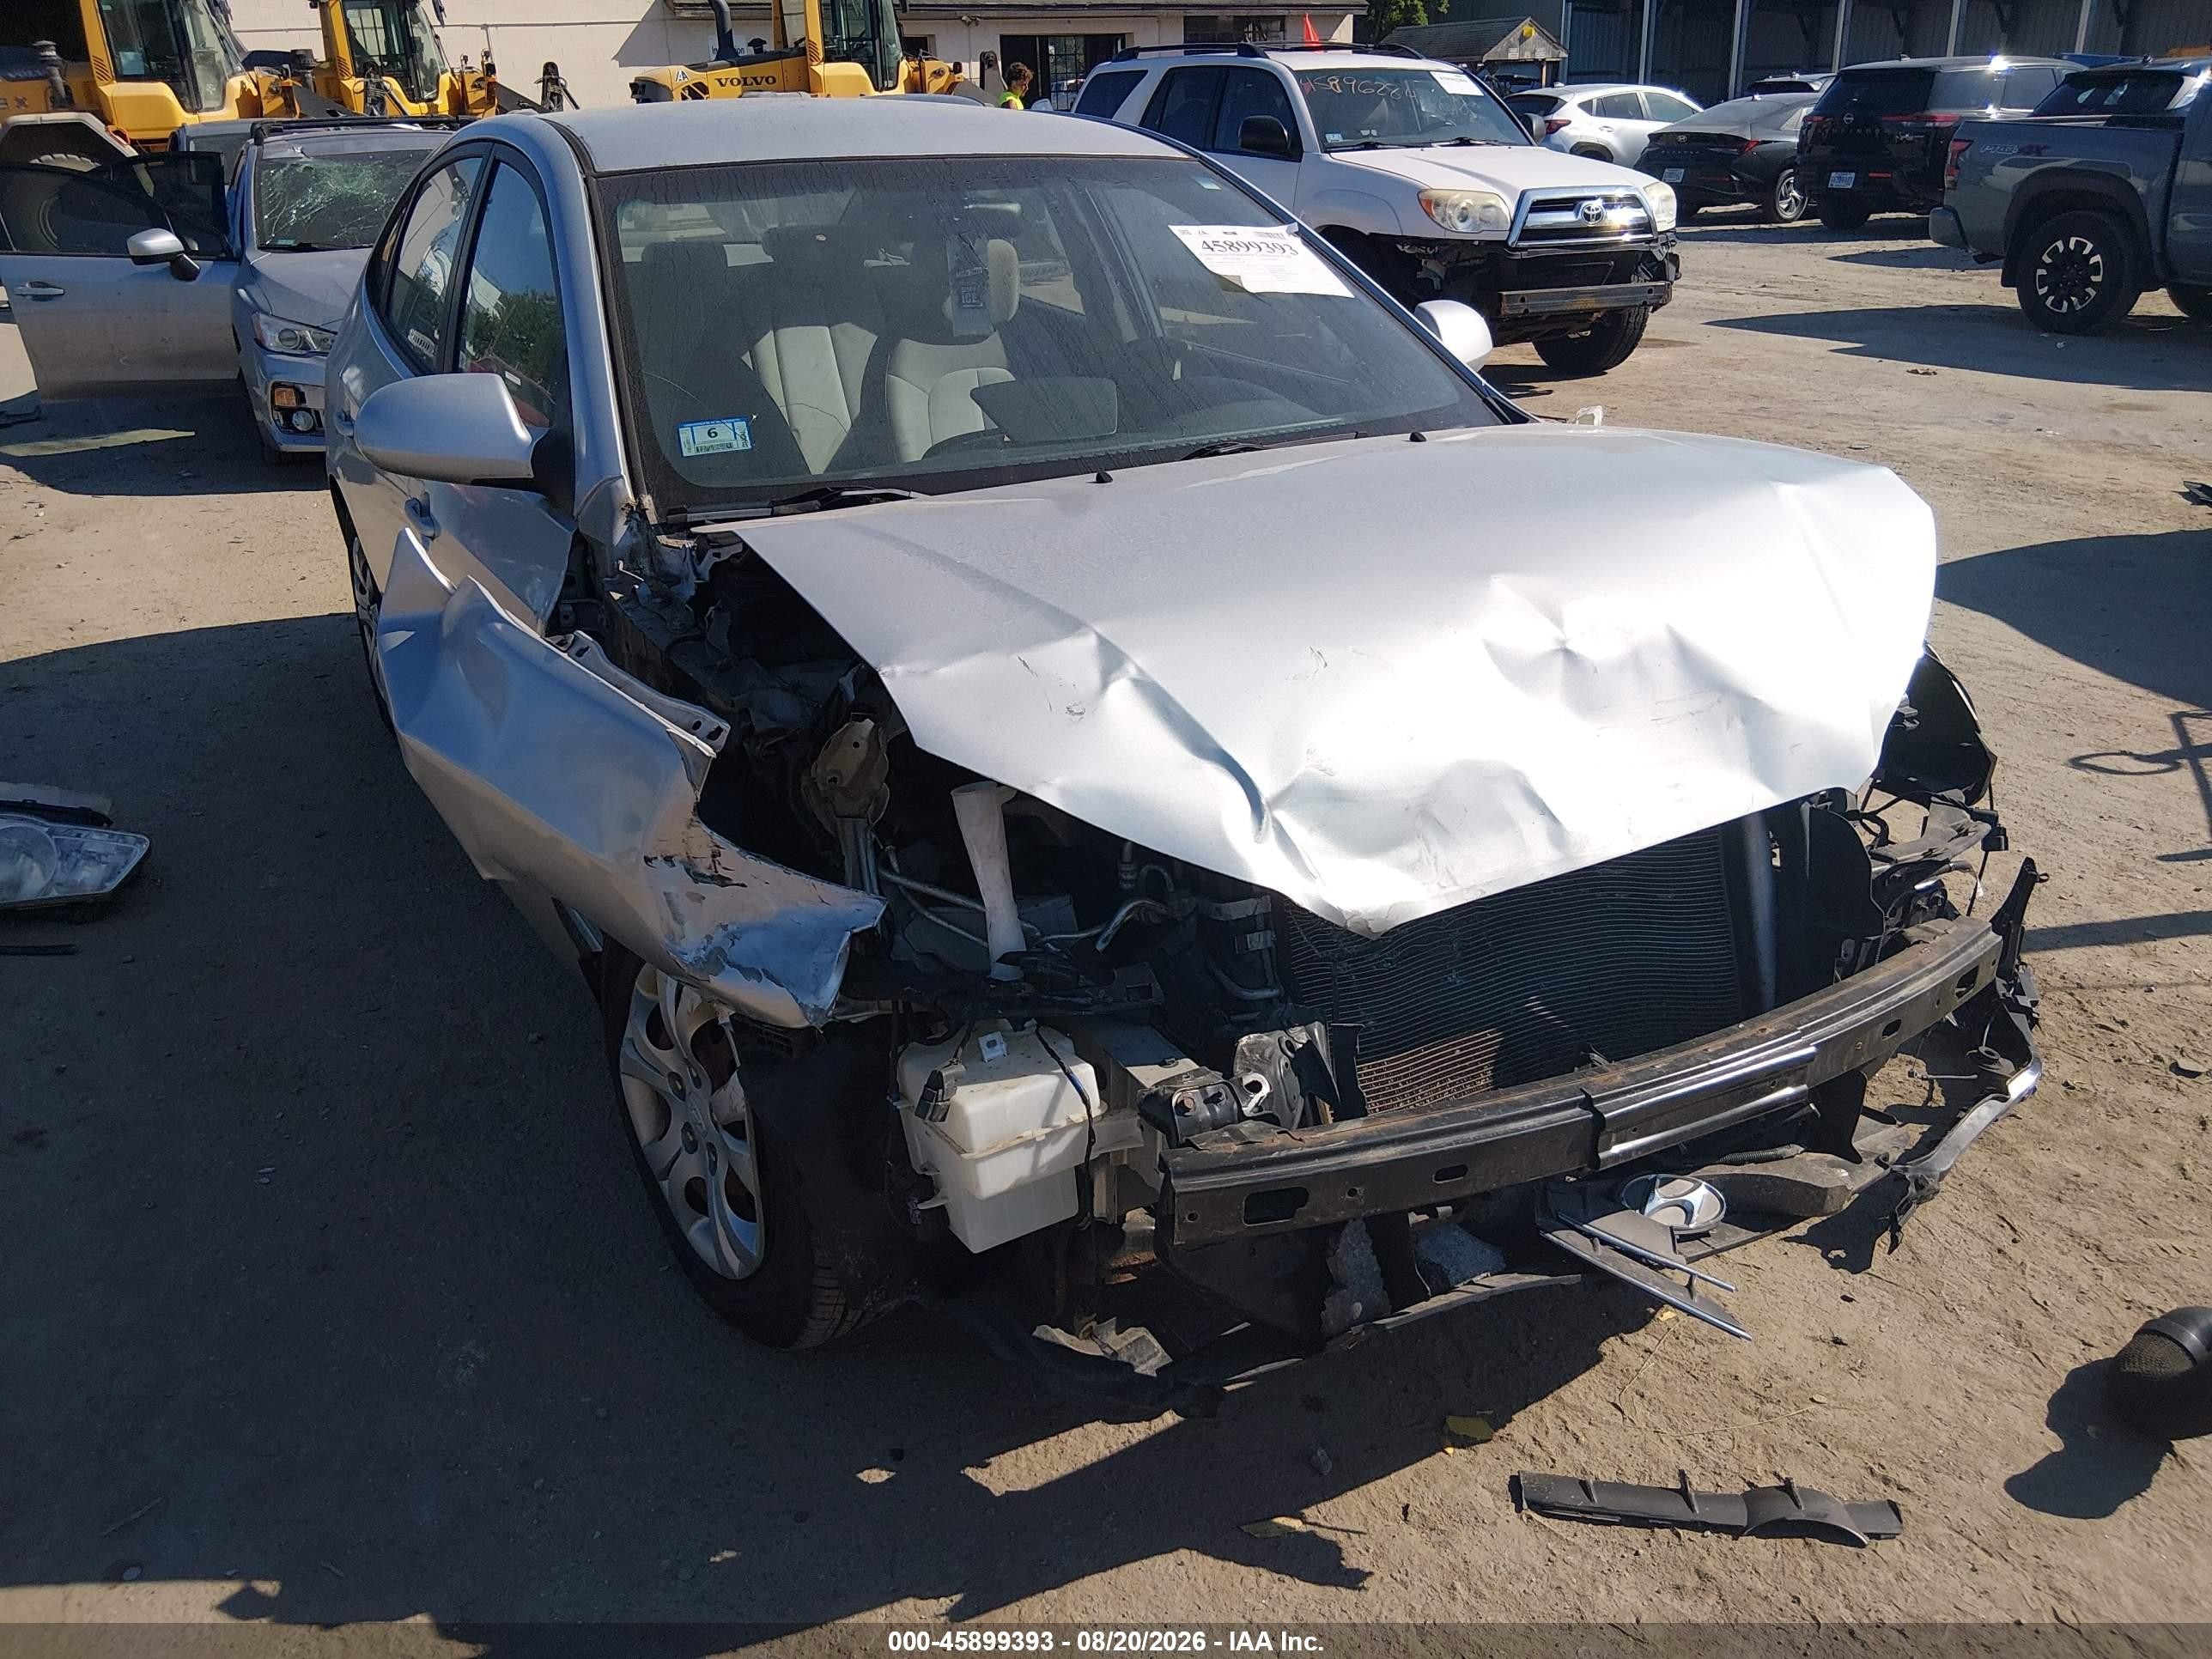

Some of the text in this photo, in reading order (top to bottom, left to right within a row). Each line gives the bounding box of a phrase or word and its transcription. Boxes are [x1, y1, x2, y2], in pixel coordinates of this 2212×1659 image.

[714, 76, 777, 88] VOLVO
[1200, 240, 1299, 256] 45899393
[707, 427, 718, 439] 6
